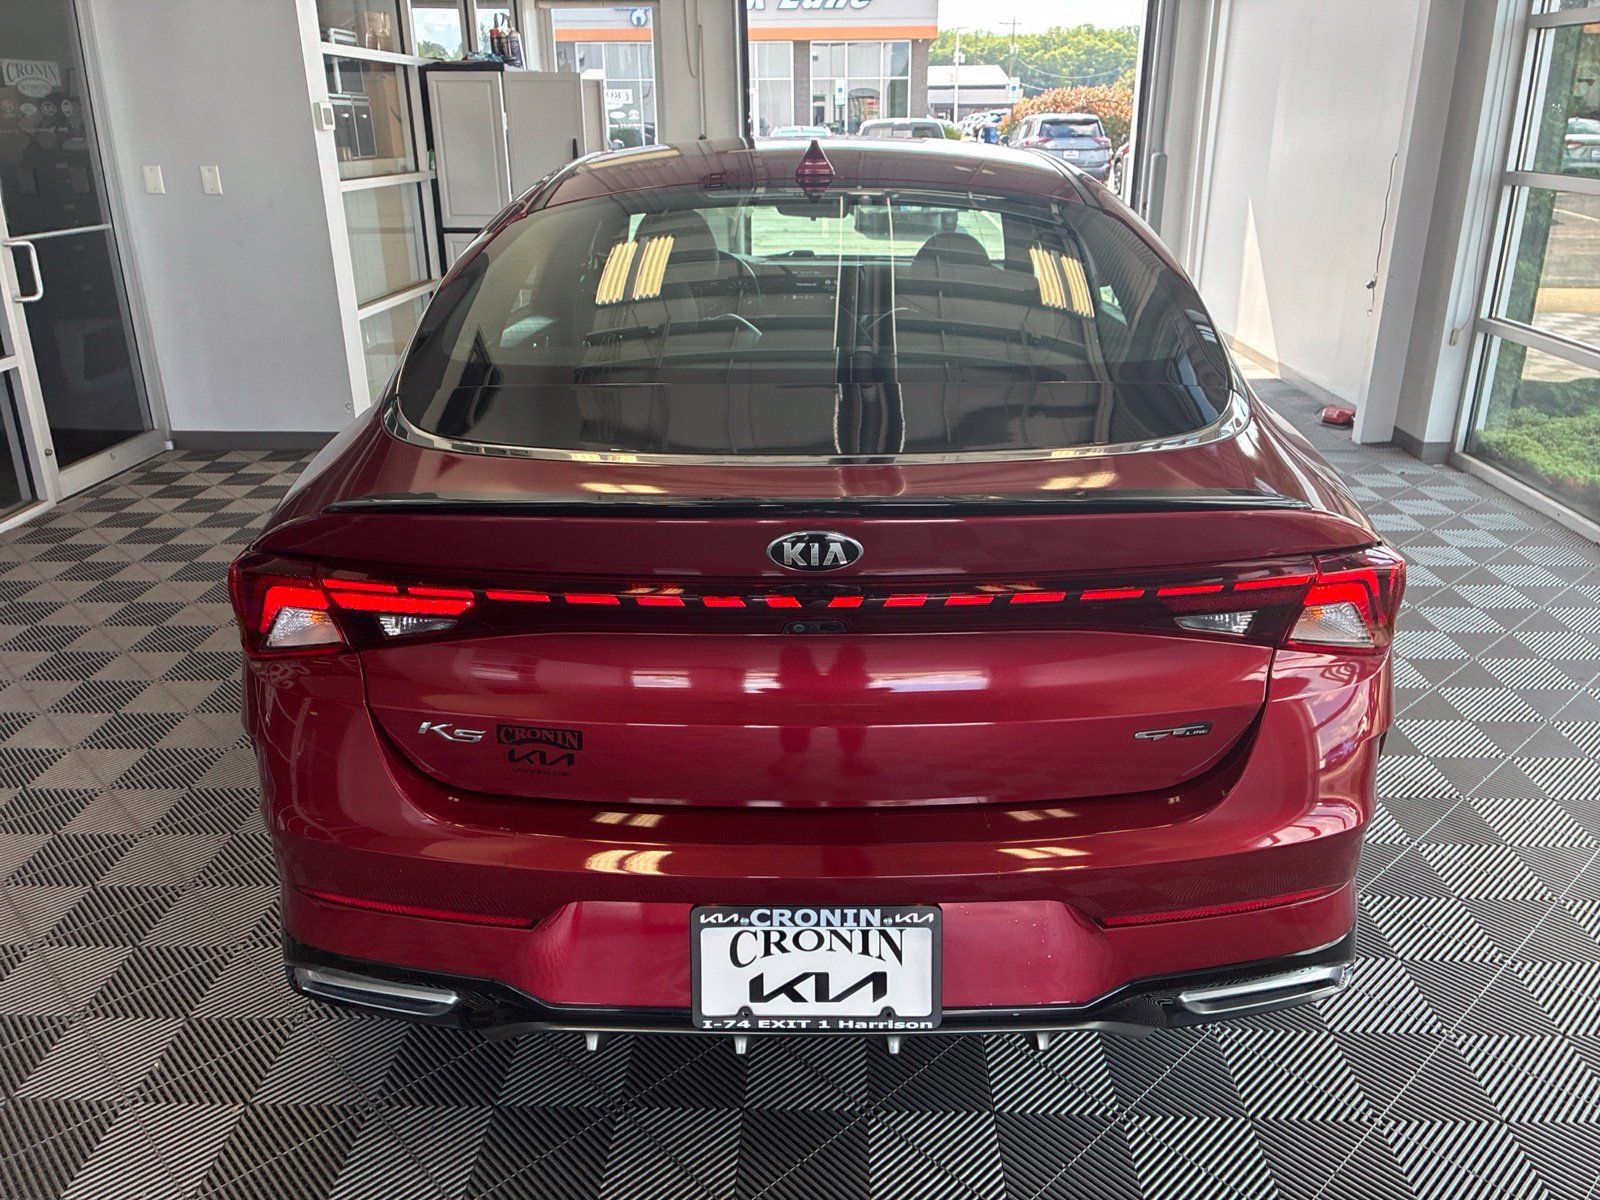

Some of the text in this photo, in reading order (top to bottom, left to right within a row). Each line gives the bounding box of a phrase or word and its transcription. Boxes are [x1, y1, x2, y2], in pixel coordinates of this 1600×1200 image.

[782, 541, 848, 567] KIA
[499, 724, 580, 750] CRONIN
[508, 748, 576, 768] KIA
[699, 908, 935, 928] KIA CRONIN KIA
[729, 928, 907, 969] CRONIN
[748, 971, 888, 1004] KIA
[702, 1018, 934, 1030] I-74 EXIT 1 Harrison
